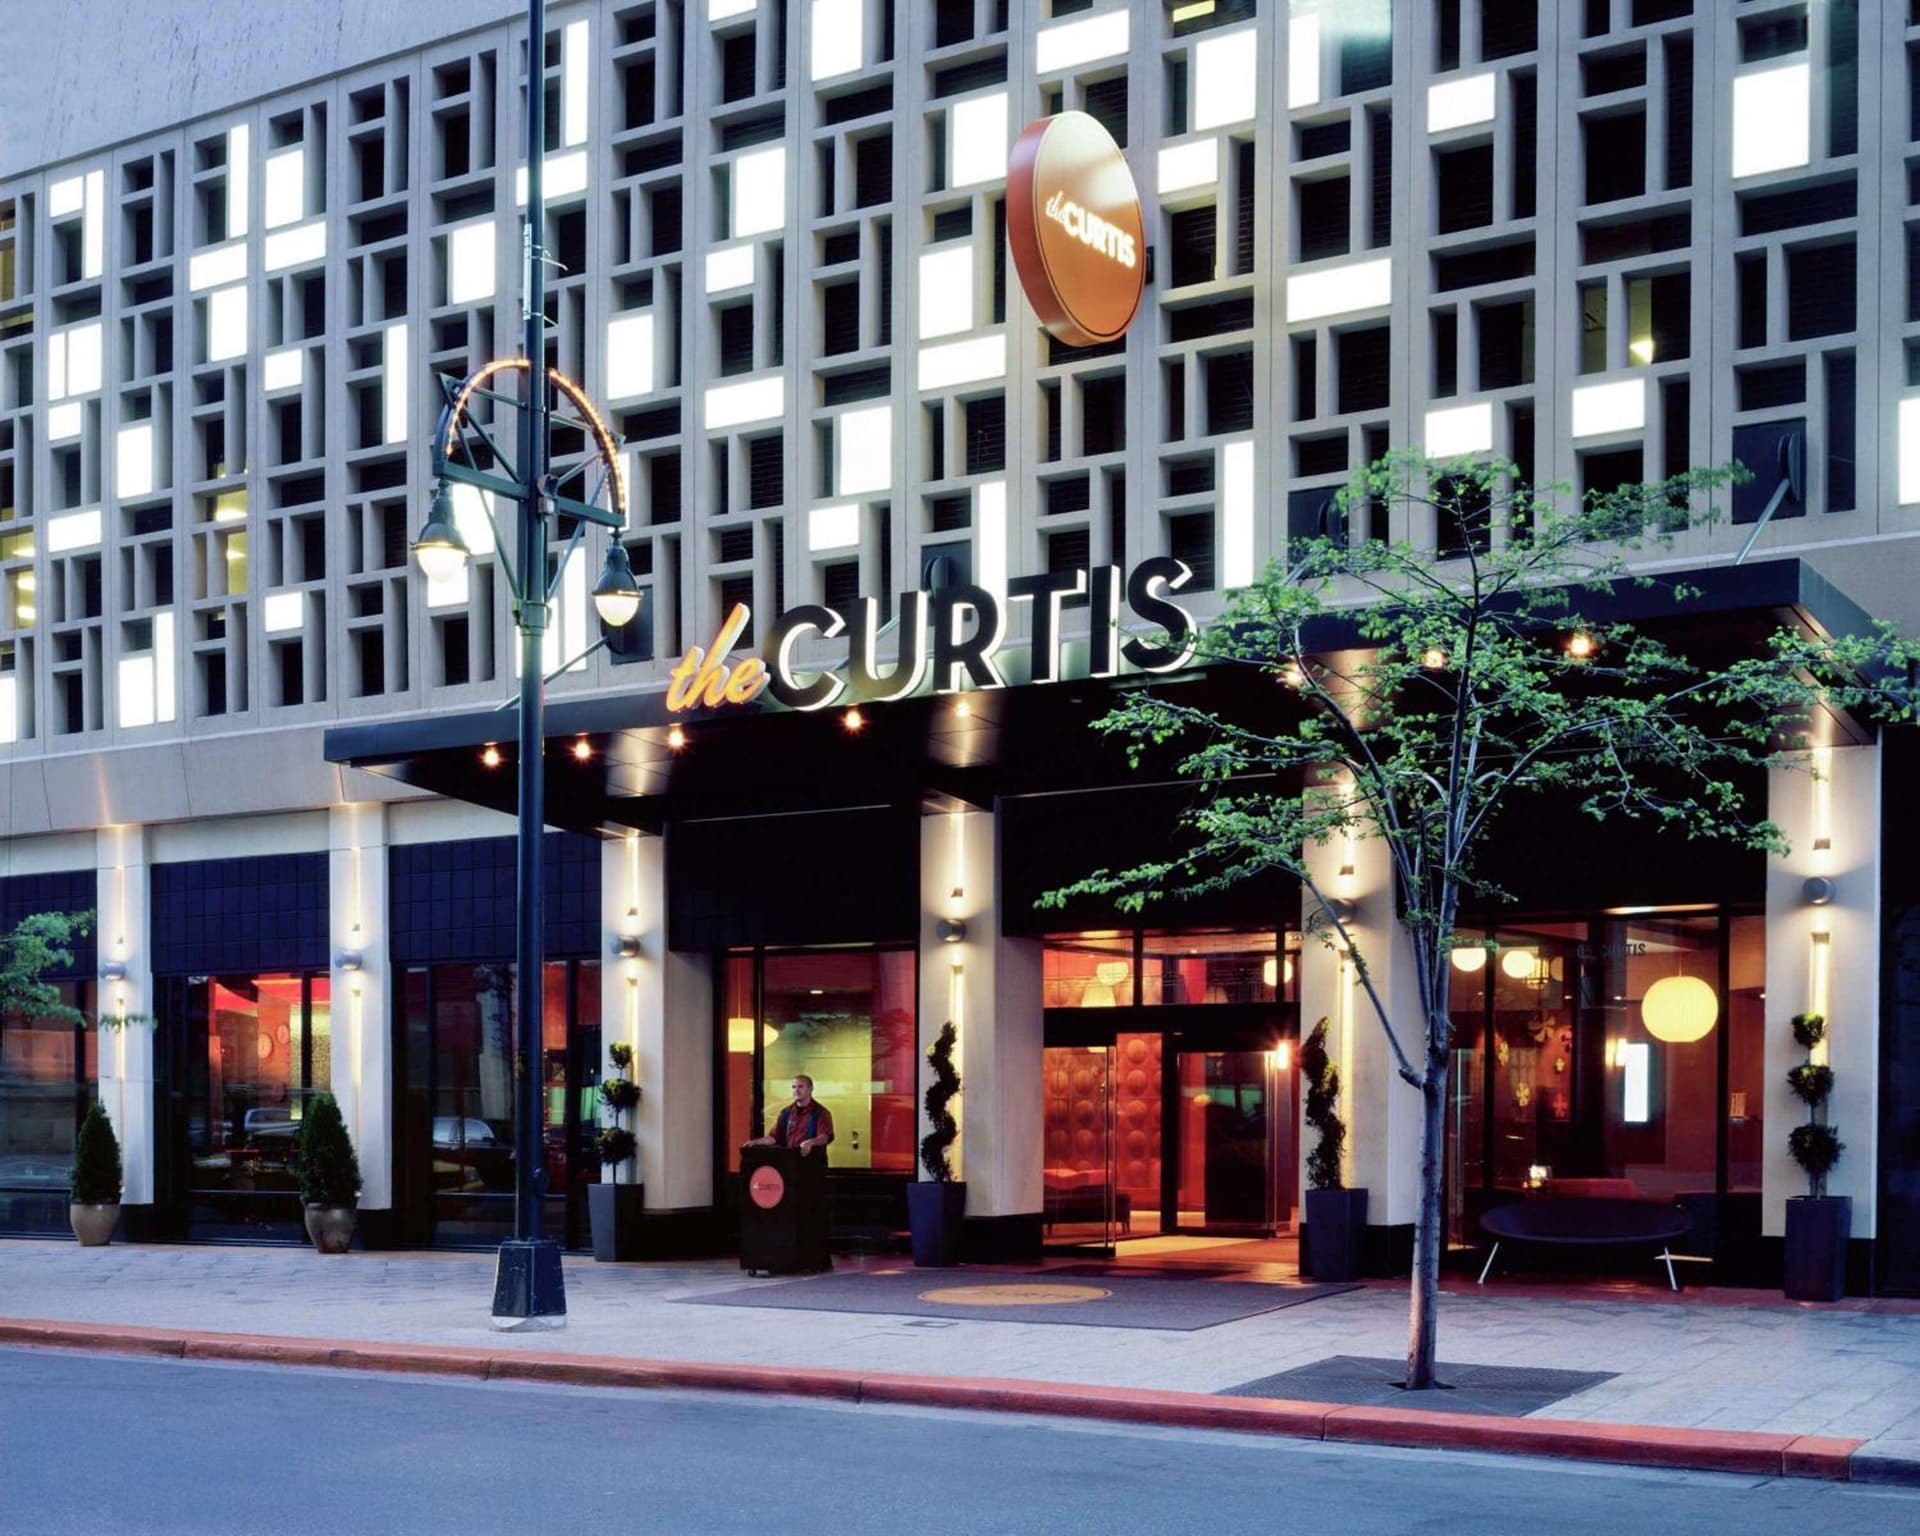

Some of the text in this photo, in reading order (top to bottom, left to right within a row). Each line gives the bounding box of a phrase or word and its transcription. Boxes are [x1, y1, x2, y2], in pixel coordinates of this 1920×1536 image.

[1063, 201, 1136, 268] CURTIS
[666, 556, 1199, 712] the CURTIS
